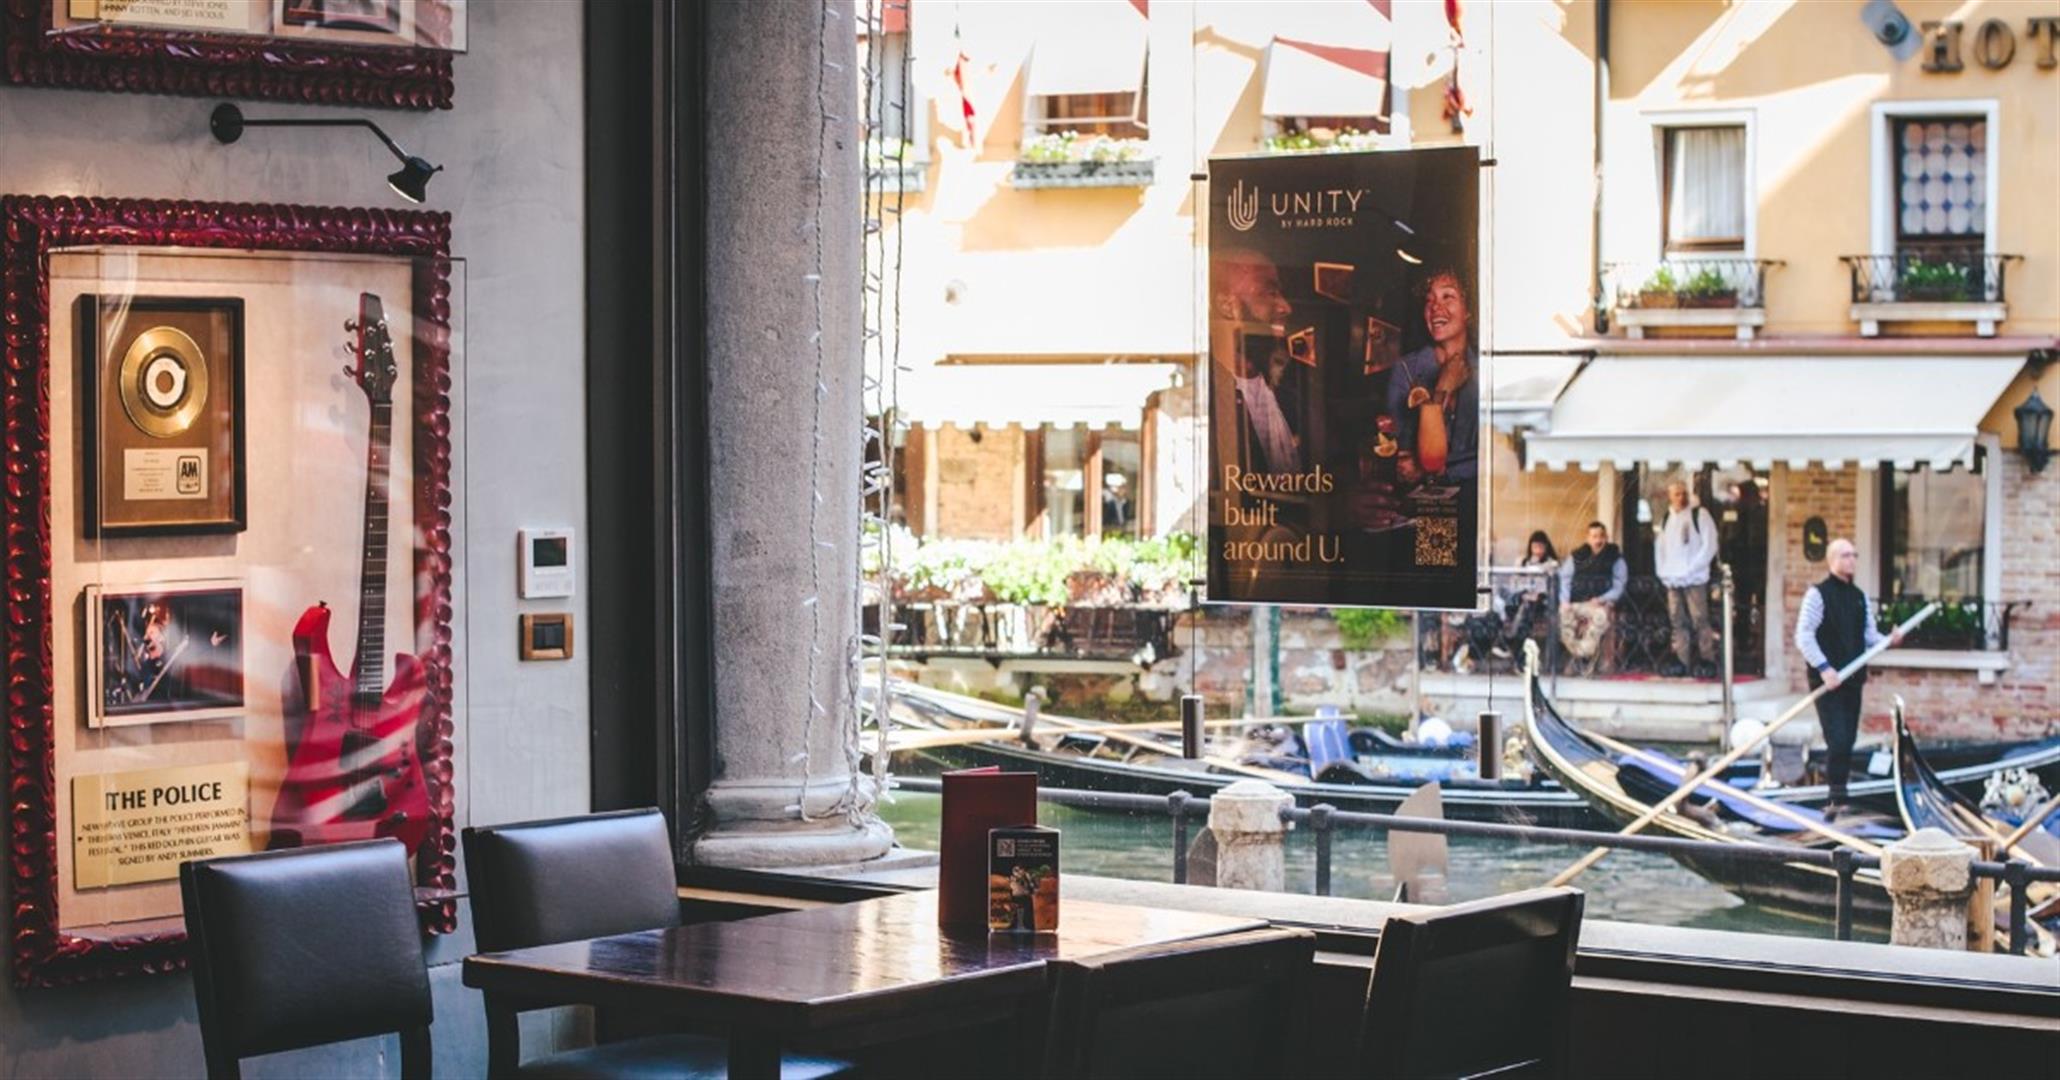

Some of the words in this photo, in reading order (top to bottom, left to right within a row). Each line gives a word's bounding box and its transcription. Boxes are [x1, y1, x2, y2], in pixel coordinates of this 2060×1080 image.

[1921, 17, 2060, 73] HOT
[1272, 189, 1362, 216] UNITY
[1281, 220, 1292, 228] BY
[1296, 218, 1322, 227] HARD
[1326, 216, 1353, 226] ROCK
[1225, 464, 1333, 492] Rewards
[1224, 499, 1278, 527] built
[1223, 534, 1311, 562] around
[1319, 535, 1345, 563] U.
[106, 790, 146, 811] THE
[153, 782, 222, 807] POLICE
[127, 817, 153, 828] GROUP
[155, 815, 168, 824] THE
[169, 813, 193, 823] POLICE
[195, 808, 236, 820] PERFORMED
[238, 807, 245, 815] IN
[131, 843, 146, 852] THIS
[147, 840, 161, 850] RED
[163, 837, 194, 849] DOLPHIN
[196, 834, 222, 845] GUITAR
[224, 832, 240, 841] WAS
[118, 855, 145, 866] SIGNED
[146, 854, 155, 863] BY
[157, 851, 177, 862] ANDY
